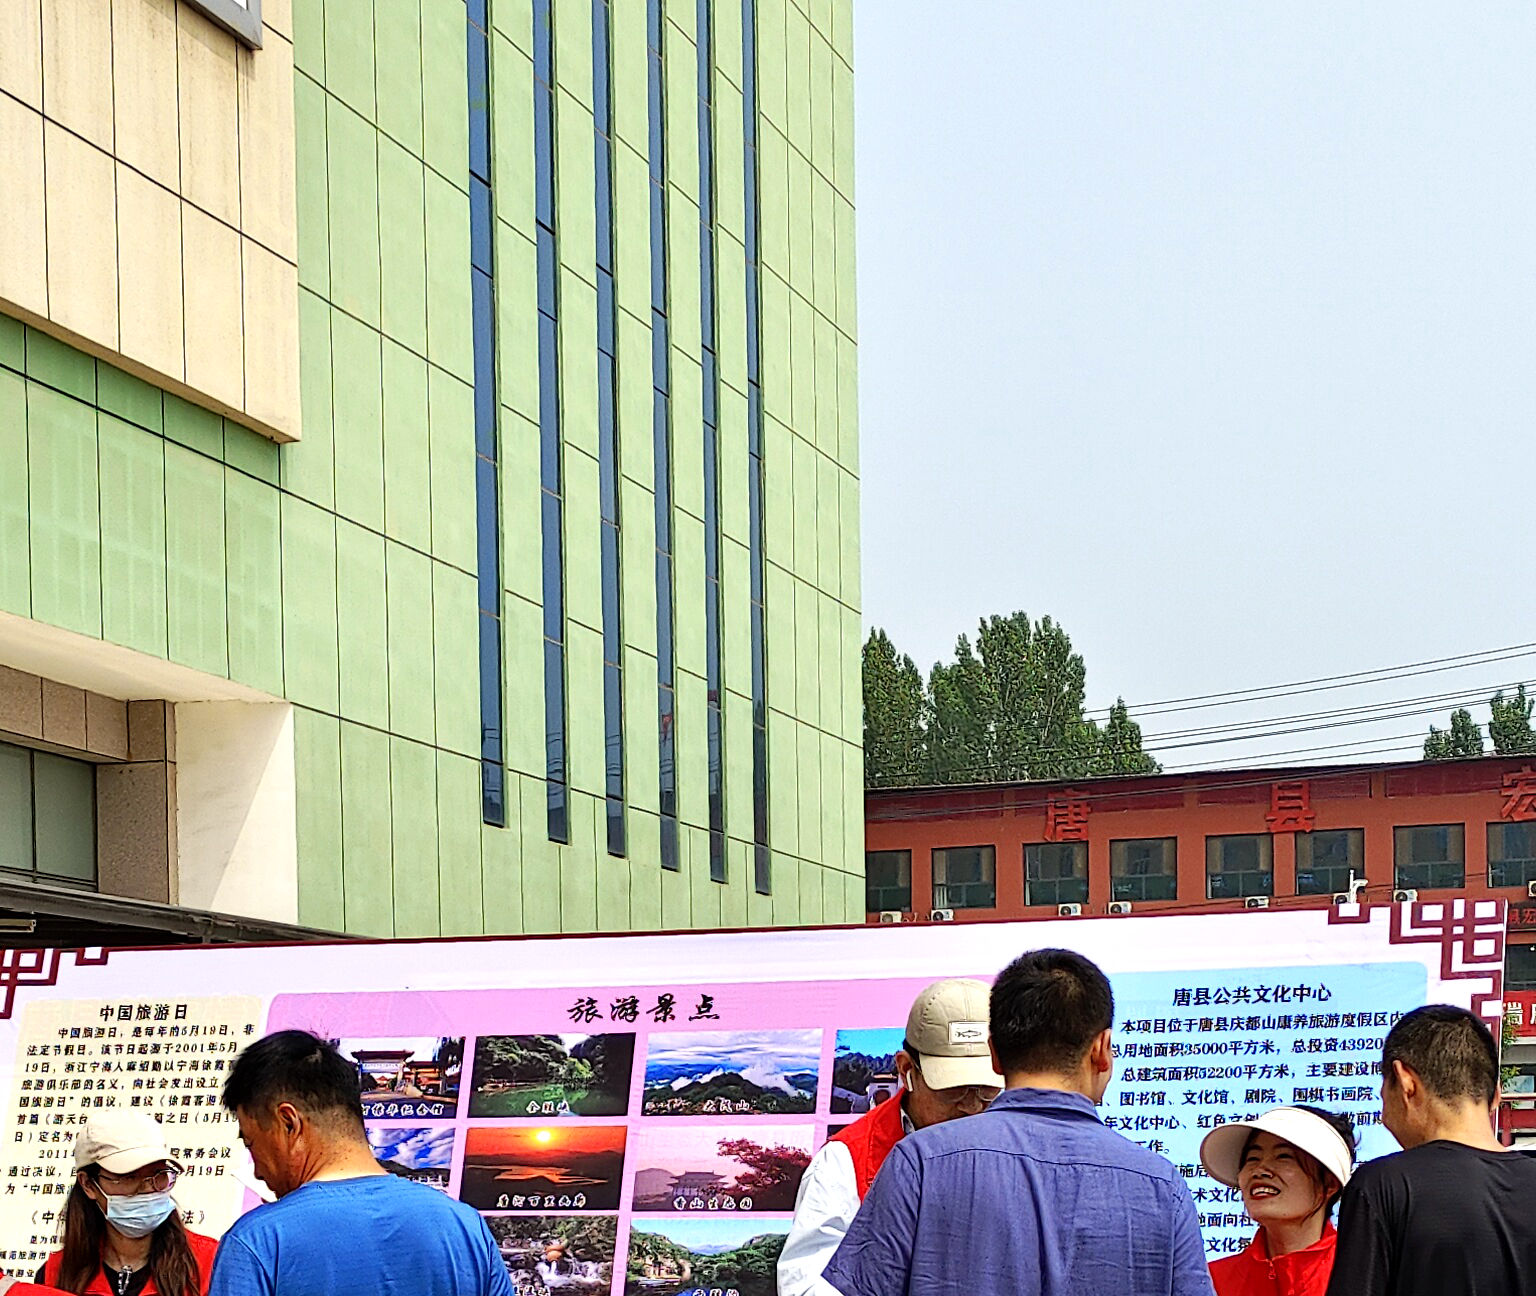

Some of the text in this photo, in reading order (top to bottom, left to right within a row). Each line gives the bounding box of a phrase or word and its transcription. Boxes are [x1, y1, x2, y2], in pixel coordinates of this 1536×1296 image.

[1172, 982, 1333, 1008] 唐县公共文化中心
[99, 1003, 189, 1022] 中国旅游日
[566, 993, 723, 1026] 旅游景点
